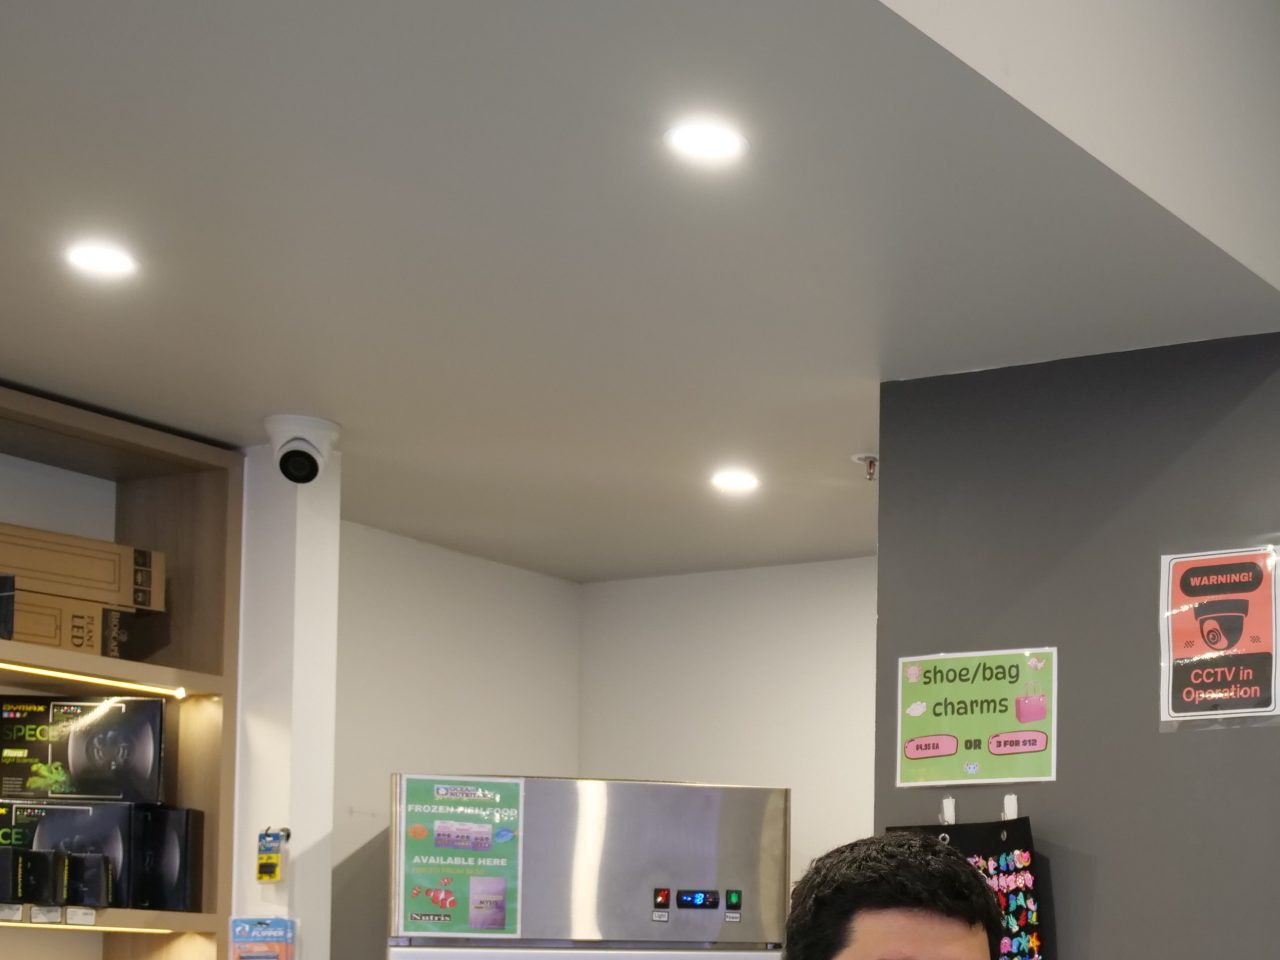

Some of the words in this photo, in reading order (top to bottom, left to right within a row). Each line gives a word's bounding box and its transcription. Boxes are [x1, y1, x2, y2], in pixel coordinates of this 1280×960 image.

[1190, 571, 1253, 587] WARNING!
[71, 614, 85, 648] LED
[922, 661, 1020, 685] shoe/bag
[1190, 667, 1236, 684] CCTV
[1239, 666, 1253, 681] in
[1182, 684, 1261, 704] Operation
[932, 697, 1009, 718] charms
[964, 739, 982, 751] OR
[1003, 739, 1020, 748] FOR
[1021, 738, 1037, 748] $12
[408, 804, 454, 813] FROZEN
[413, 855, 476, 865] AVAILABLE
[478, 857, 508, 866] HERE
